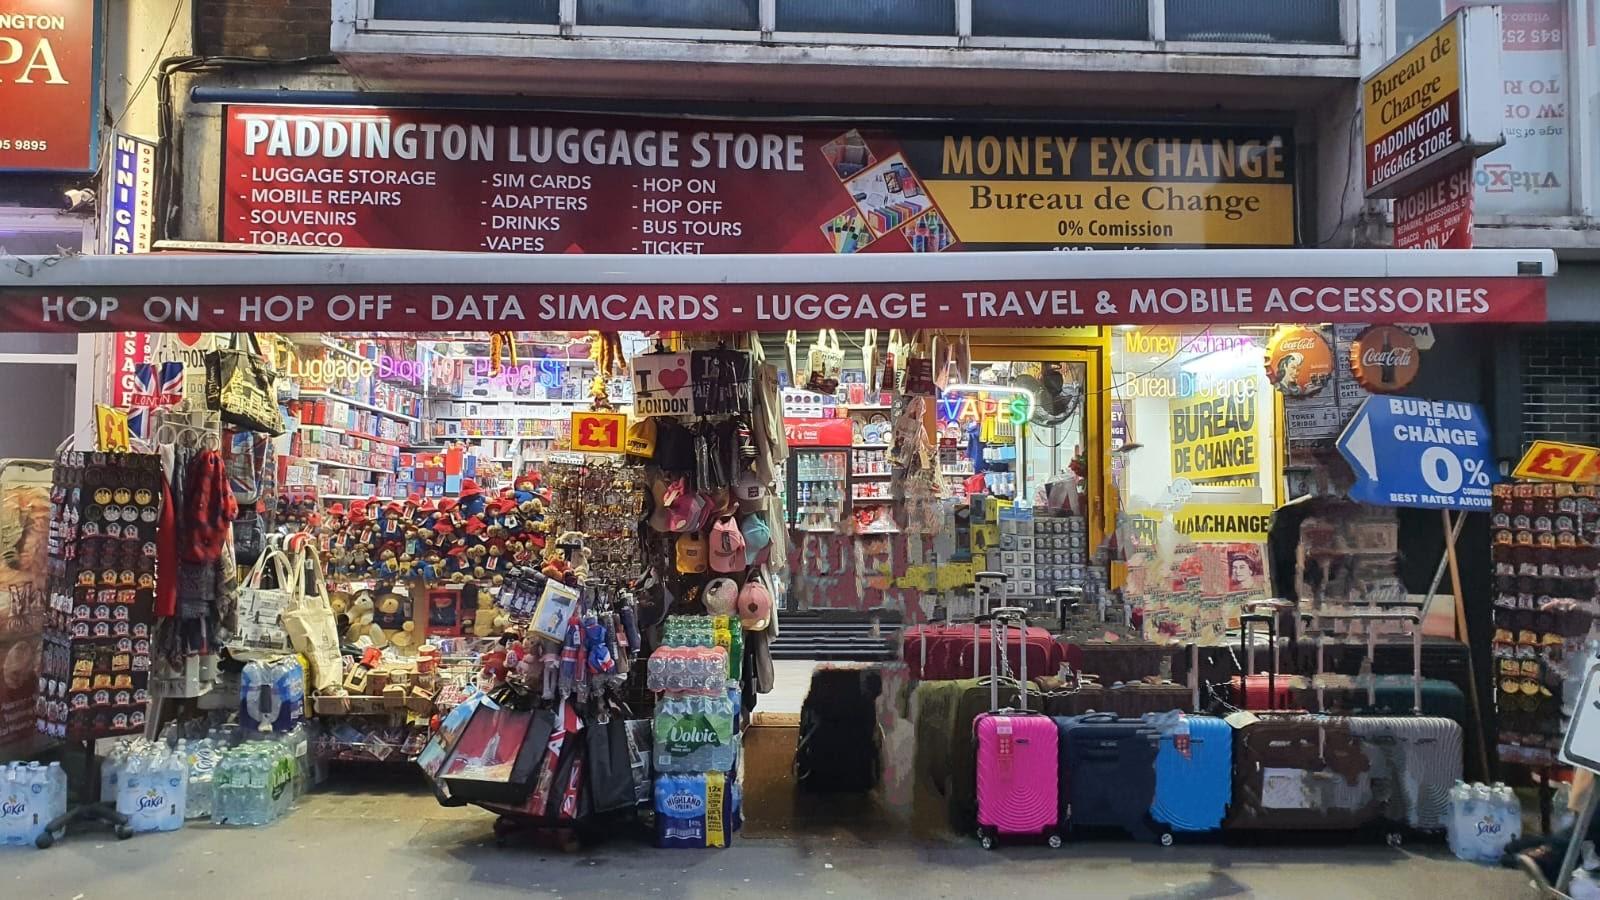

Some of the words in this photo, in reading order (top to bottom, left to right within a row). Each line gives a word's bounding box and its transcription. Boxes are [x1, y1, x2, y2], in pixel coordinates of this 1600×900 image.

[1530, 29, 1561, 43] 845
[1370, 58, 1426, 104] Bureau
[1431, 35, 1452, 64] de
[1529, 80, 1560, 95] TO
[1380, 76, 1442, 125] Change
[1373, 101, 1450, 162] PADDINGTON
[15, 140, 47, 151] 9895
[244, 116, 494, 161] PADDINGTON
[509, 126, 680, 168] LUGGAGE
[691, 131, 805, 171] STORE
[942, 135, 1079, 177] MONEY
[1090, 135, 1284, 179] EXCHANGE
[1372, 146, 1415, 186] LUGGAGE
[1418, 127, 1453, 161] STORE
[251, 167, 344, 184] LUGGAGE
[348, 171, 437, 186] STORAGE
[492, 173, 525, 188] SIM
[529, 175, 592, 190] CARDS
[643, 178, 683, 193] HOP
[687, 179, 717, 194] ON
[251, 189, 323, 204] MOBILE
[328, 191, 401, 206] REPAIRS
[492, 195, 588, 211] ADAPTERS
[643, 199, 683, 214] HOP
[687, 200, 723, 215] OFF
[970, 185, 1084, 211] Bureau
[1093, 184, 1131, 211] de
[1141, 184, 1261, 220] Change
[1397, 181, 1446, 224] MOBILE
[250, 209, 358, 226] SOUVENIRS
[491, 216, 561, 231] DRINKS
[643, 220, 678, 235] BUS
[682, 221, 743, 237] TOURS
[1058, 220, 1084, 238] 0%
[1088, 219, 1174, 238] Comission
[249, 231, 344, 248] TOBACCO
[642, 240, 705, 255] TICKET
[41, 296, 120, 322] HOP
[143, 296, 200, 322] ON
[239, 295, 317, 322] HOP
[327, 294, 393, 321] OFF
[430, 294, 526, 321] DATA
[538, 294, 720, 322] SIMCARDS
[756, 292, 928, 321] LUGGAGE
[963, 289, 1084, 318] TRAVEL
[1095, 289, 1118, 315] &
[1128, 287, 1254, 314] MOBILE
[1264, 286, 1490, 314] ACCESSORIES
[1126, 331, 1177, 358] Money
[286, 351, 374, 384] Luggage
[379, 354, 424, 386] Drop
[540, 357, 562, 388] St
[1125, 371, 1177, 397] Bureau
[1180, 371, 1197, 397] Di
[1199, 374, 1255, 404] Change
[637, 398, 689, 414] LONDON
[944, 396, 1028, 425] VAPES
[1388, 399, 1472, 421] BUREAU
[1173, 396, 1255, 445] BUREAU
[1426, 418, 1441, 427] DE
[579, 416, 619, 448] £1
[1393, 424, 1479, 446] CHANGE
[1174, 448, 1191, 474] DE
[1194, 435, 1255, 473] CHANGE
[1526, 448, 1586, 478] £1
[1390, 493, 1418, 502] BEST
[1421, 495, 1455, 505] RATES
[671, 726, 717, 743] Volvic
[1, 801, 25, 817] Saka
[138, 795, 164, 812] Saka
[1476, 820, 1502, 837] Saka
